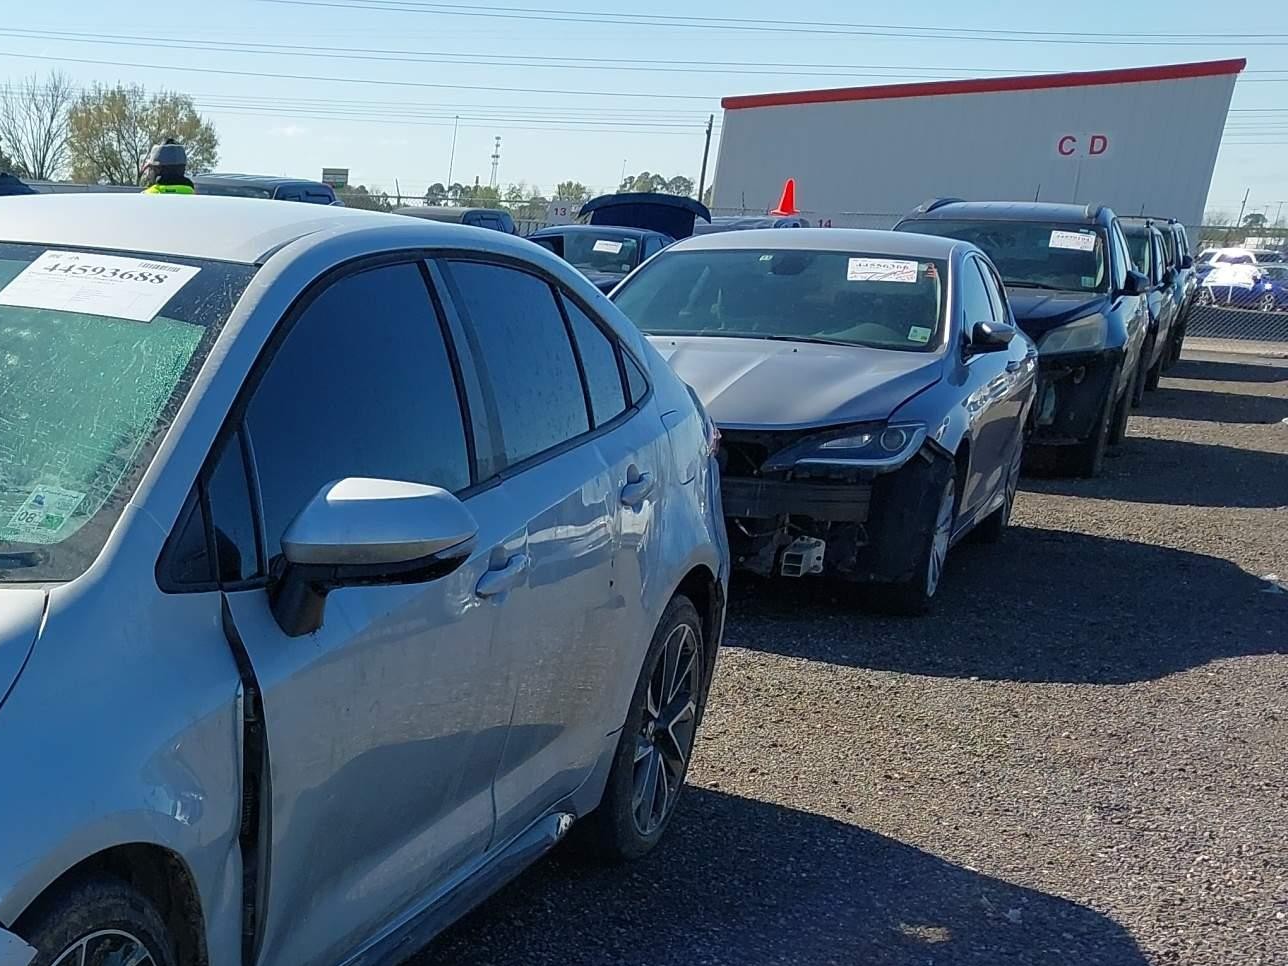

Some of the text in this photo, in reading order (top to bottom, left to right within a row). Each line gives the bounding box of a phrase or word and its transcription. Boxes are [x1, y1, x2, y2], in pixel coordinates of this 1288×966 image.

[1058, 135, 1108, 156] C D
[553, 207, 567, 216] 13
[818, 219, 832, 228] 14
[43, 262, 169, 284] 44593688
[18, 511, 37, 523] 08
